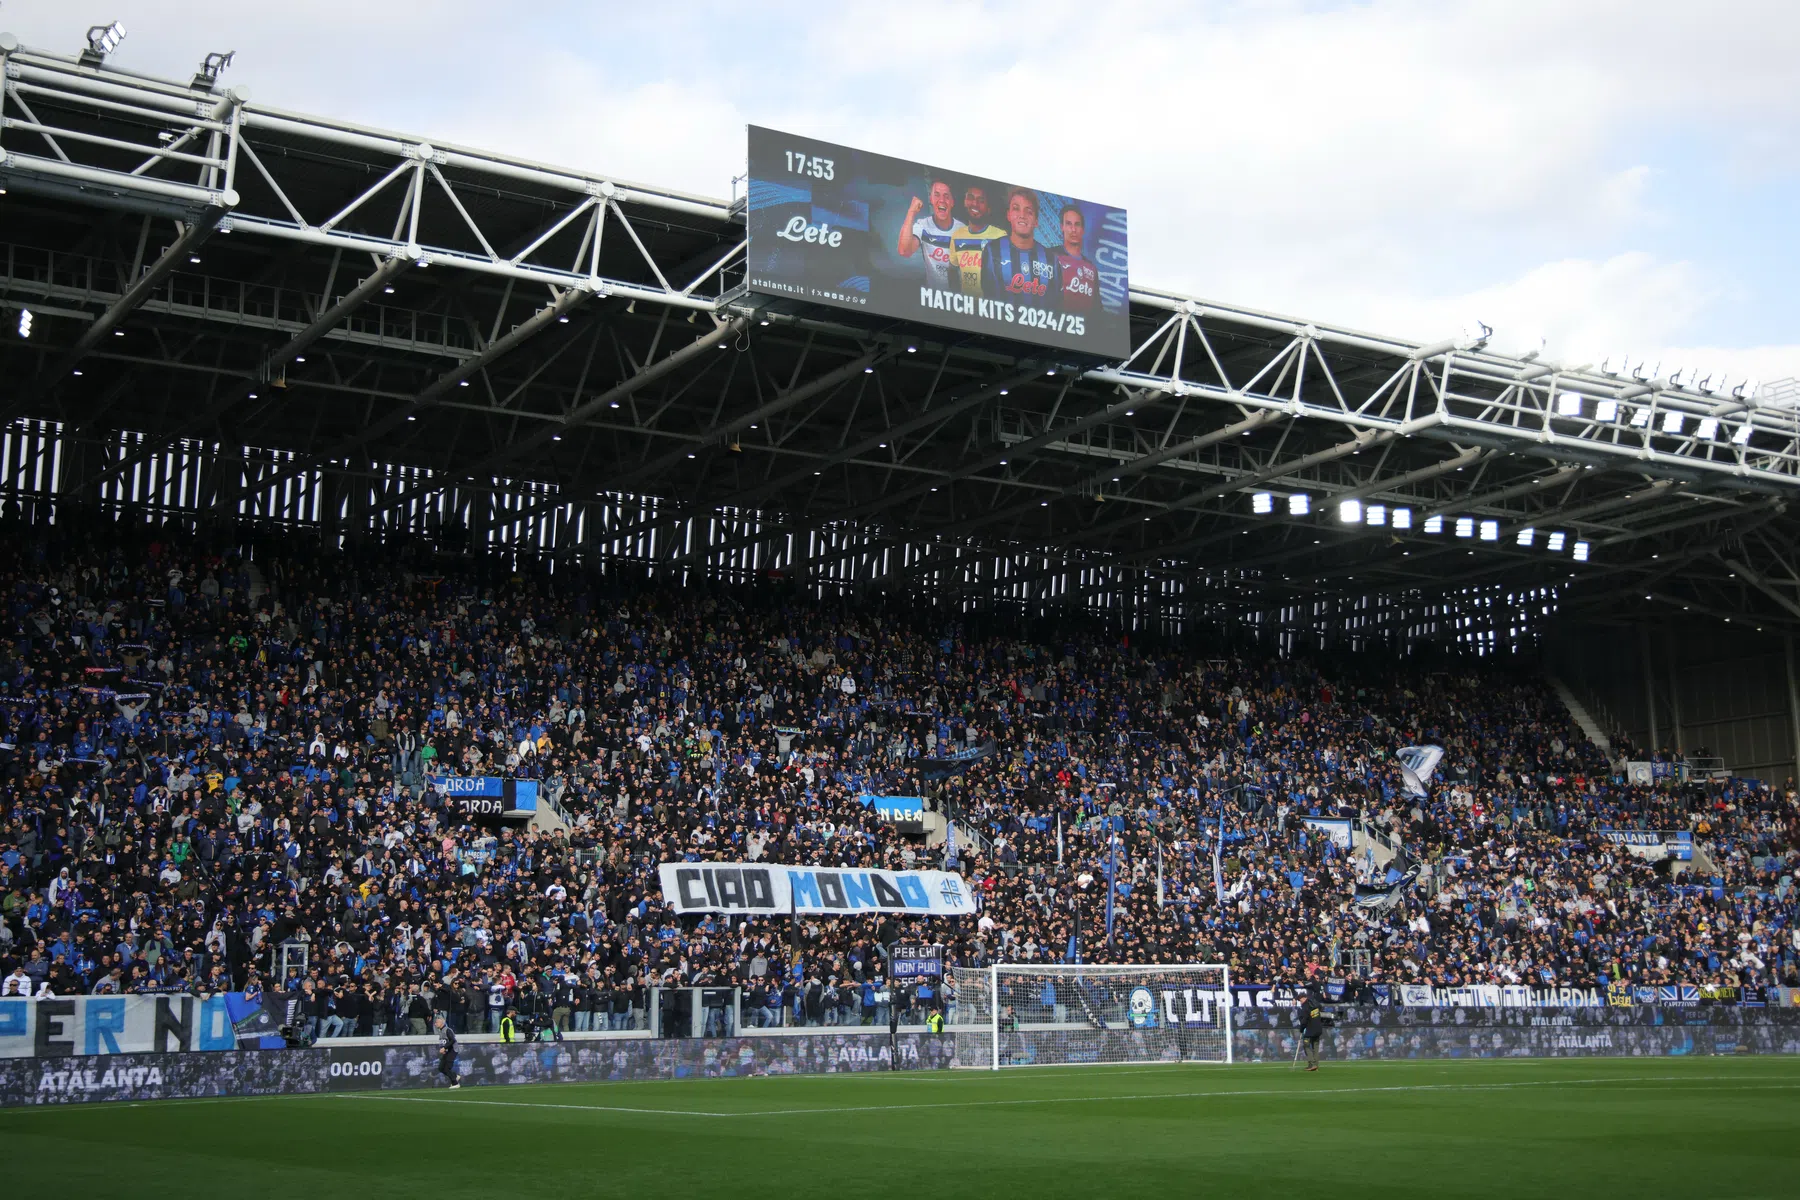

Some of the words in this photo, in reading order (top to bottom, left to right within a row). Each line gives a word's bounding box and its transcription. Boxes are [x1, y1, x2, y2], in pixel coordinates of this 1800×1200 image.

[785, 150, 835, 181] 17:53
[776, 215, 843, 248] Lete
[928, 246, 951, 264] Le
[752, 277, 804, 295] atalanta.it
[1006, 273, 1047, 297] Lete
[1066, 277, 1093, 297] Lete
[920, 286, 974, 316] MATCH
[978, 298, 1014, 323] KITS
[1018, 305, 1085, 336] 2024/25
[445, 778, 486, 792] ORDA
[1607, 832, 1660, 844] ATALANTA
[676, 868, 775, 909] CIAO
[787, 870, 931, 909] MONDO
[894, 947, 915, 957] PER
[919, 947, 936, 957] CHI
[895, 962, 914, 973] NON
[1163, 989, 1275, 1023] ULTRAS
[0, 1000, 126, 1057] PER
[1531, 1016, 1573, 1026] ATALANTA
[1558, 1034, 1613, 1048] ATALANTA
[839, 1043, 920, 1062] ATALATA
[330, 1060, 382, 1077] 00:00
[38, 1066, 163, 1091] ATALANTA
